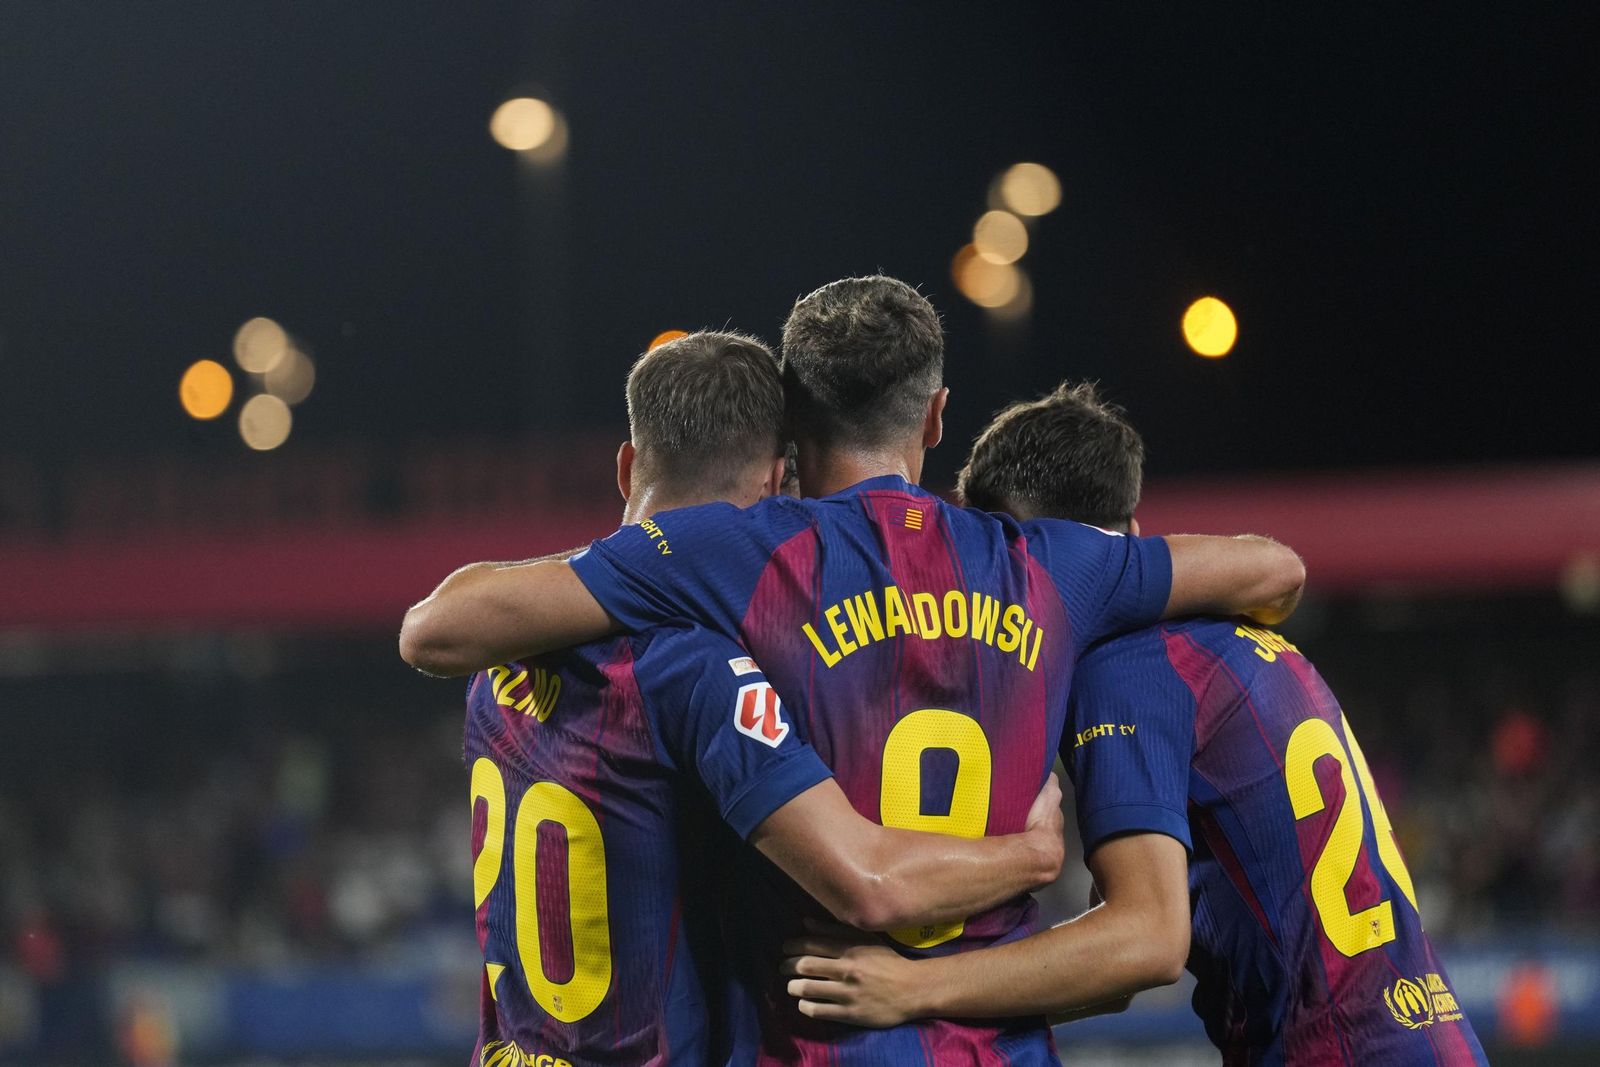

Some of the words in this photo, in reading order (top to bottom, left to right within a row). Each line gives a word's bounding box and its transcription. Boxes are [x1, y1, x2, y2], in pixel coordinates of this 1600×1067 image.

[640, 519, 664, 540] GHT
[657, 539, 673, 555] tv
[801, 585, 1044, 672] LEWADOWSI
[1119, 724, 1136, 736] tv
[879, 708, 992, 949] 9
[470, 756, 613, 1023] 20
